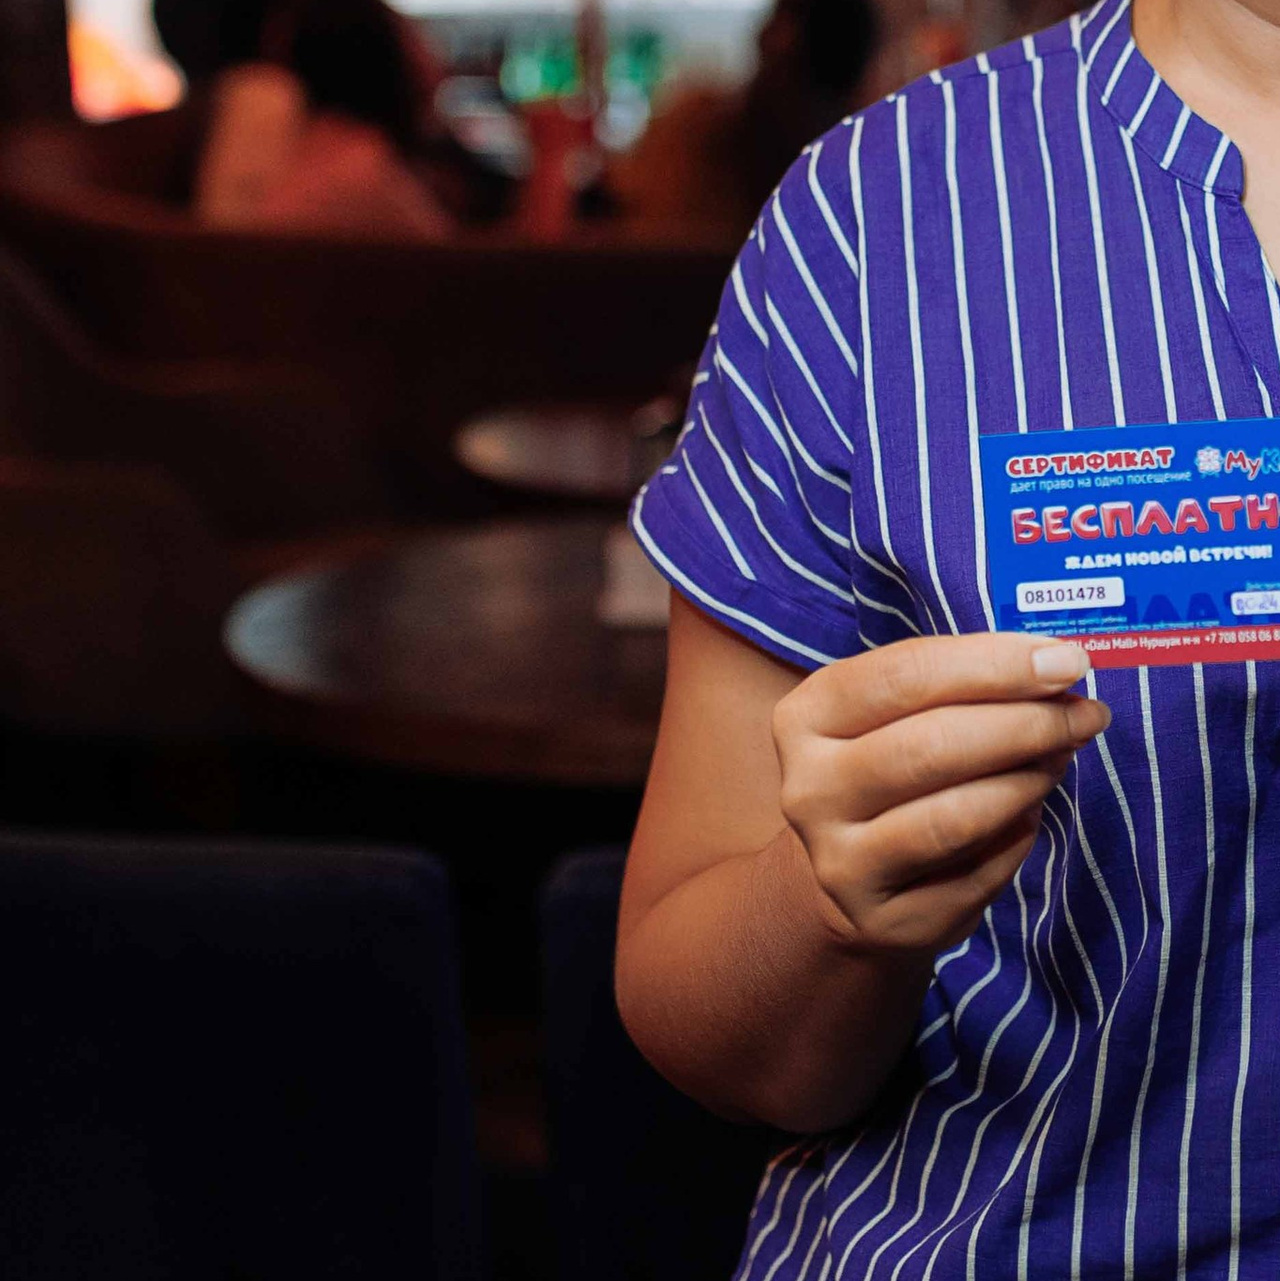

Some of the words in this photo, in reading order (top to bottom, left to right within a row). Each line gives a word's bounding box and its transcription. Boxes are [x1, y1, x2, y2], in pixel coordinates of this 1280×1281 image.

[1007, 447, 1174, 477] СЕРТИФИКАТ
[1010, 480, 1036, 494] дает
[1039, 478, 1074, 493] право
[1077, 477, 1092, 488] на
[1094, 475, 1124, 487] одно
[1127, 471, 1191, 485] посещение
[1065, 553, 1122, 569] ЖДЕМ
[1125, 545, 1187, 566] НОВОЙ
[1189, 545, 1273, 563] ВСТРЕЧИ!
[1025, 586, 1106, 604] 08101478
